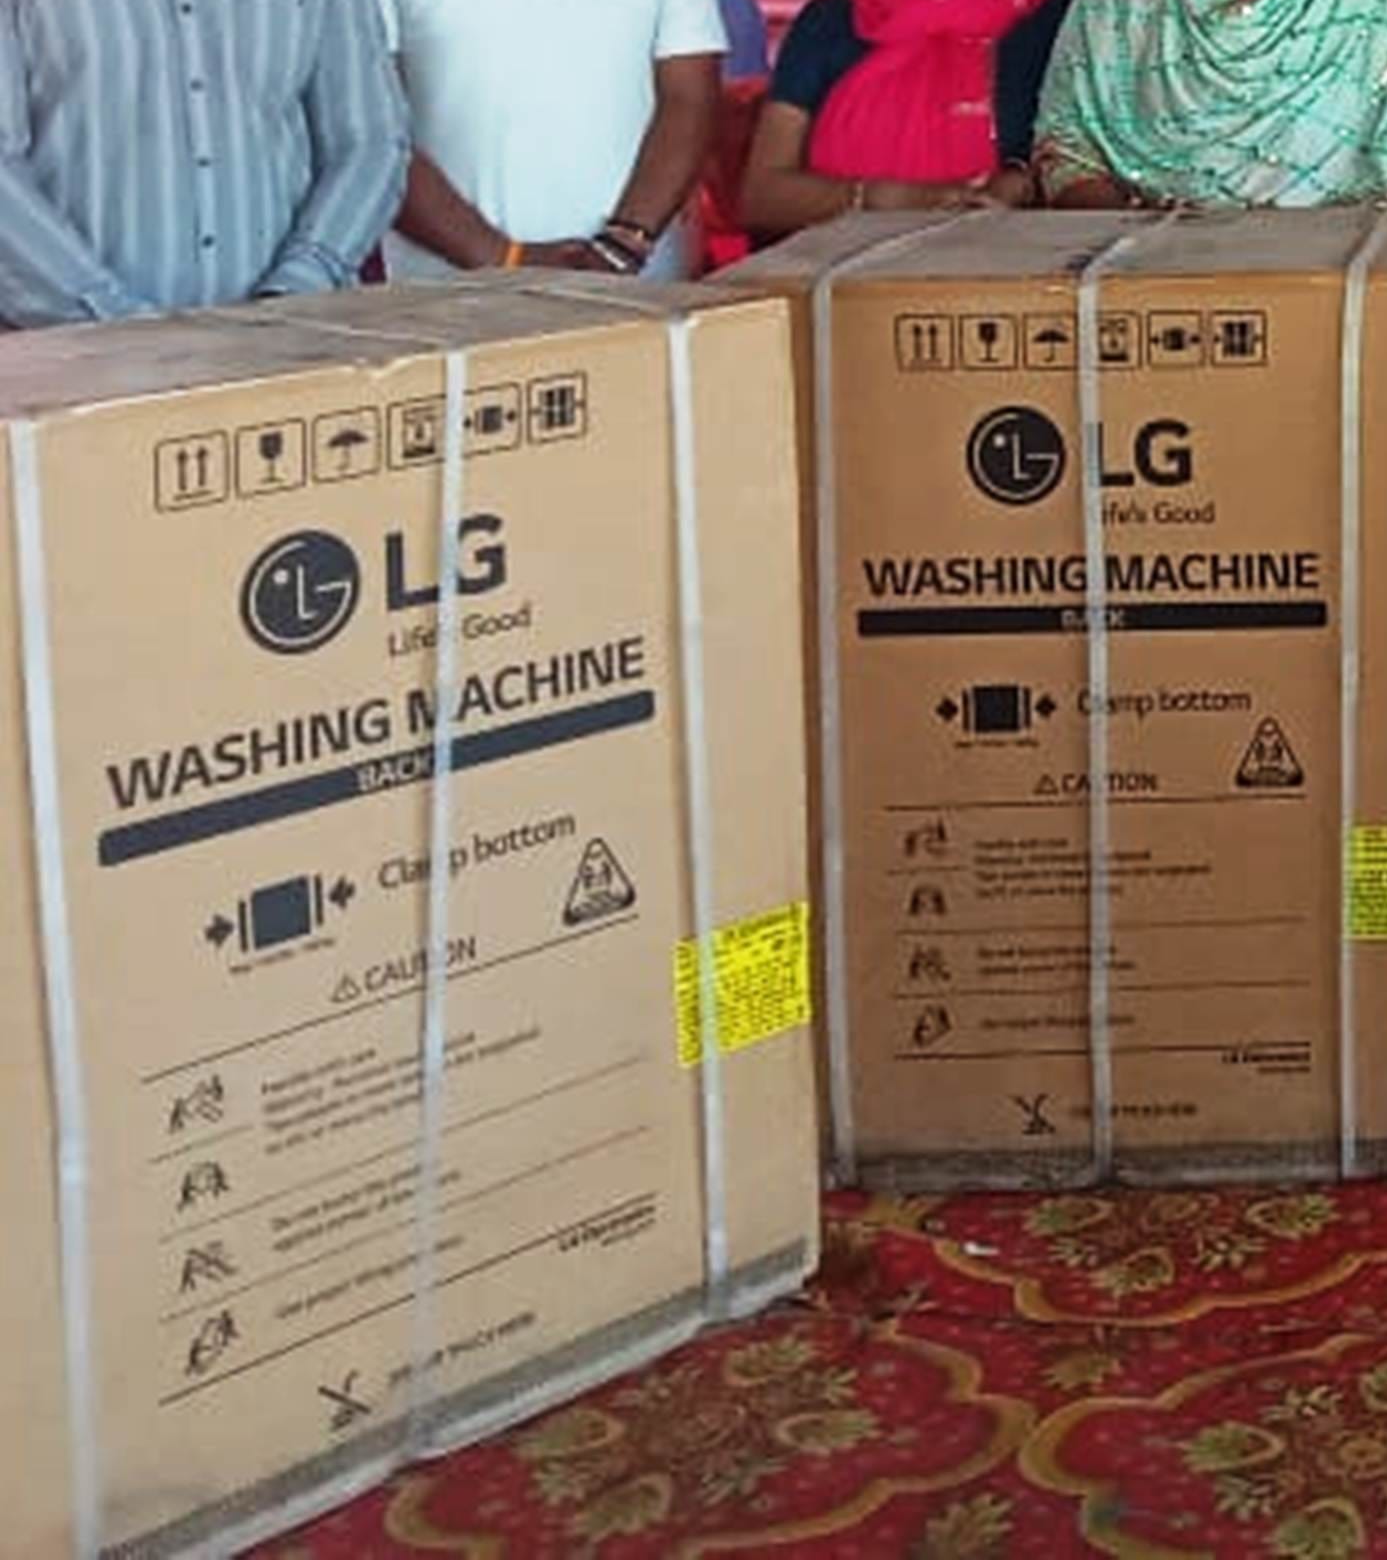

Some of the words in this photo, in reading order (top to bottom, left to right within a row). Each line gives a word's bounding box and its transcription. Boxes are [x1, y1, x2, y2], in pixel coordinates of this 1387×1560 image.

[1088, 418, 1192, 487] LG
[1101, 500, 1149, 526] ife's
[1153, 500, 1217, 526] Good
[384, 513, 508, 613] LG
[862, 555, 1090, 598] WASHING
[1103, 552, 1321, 592] MACHINE
[461, 600, 534, 642] Good
[105, 697, 393, 810] WASHING
[406, 635, 647, 735] MACHINE
[1159, 688, 1253, 713] bottom
[472, 813, 577, 866] bottom
